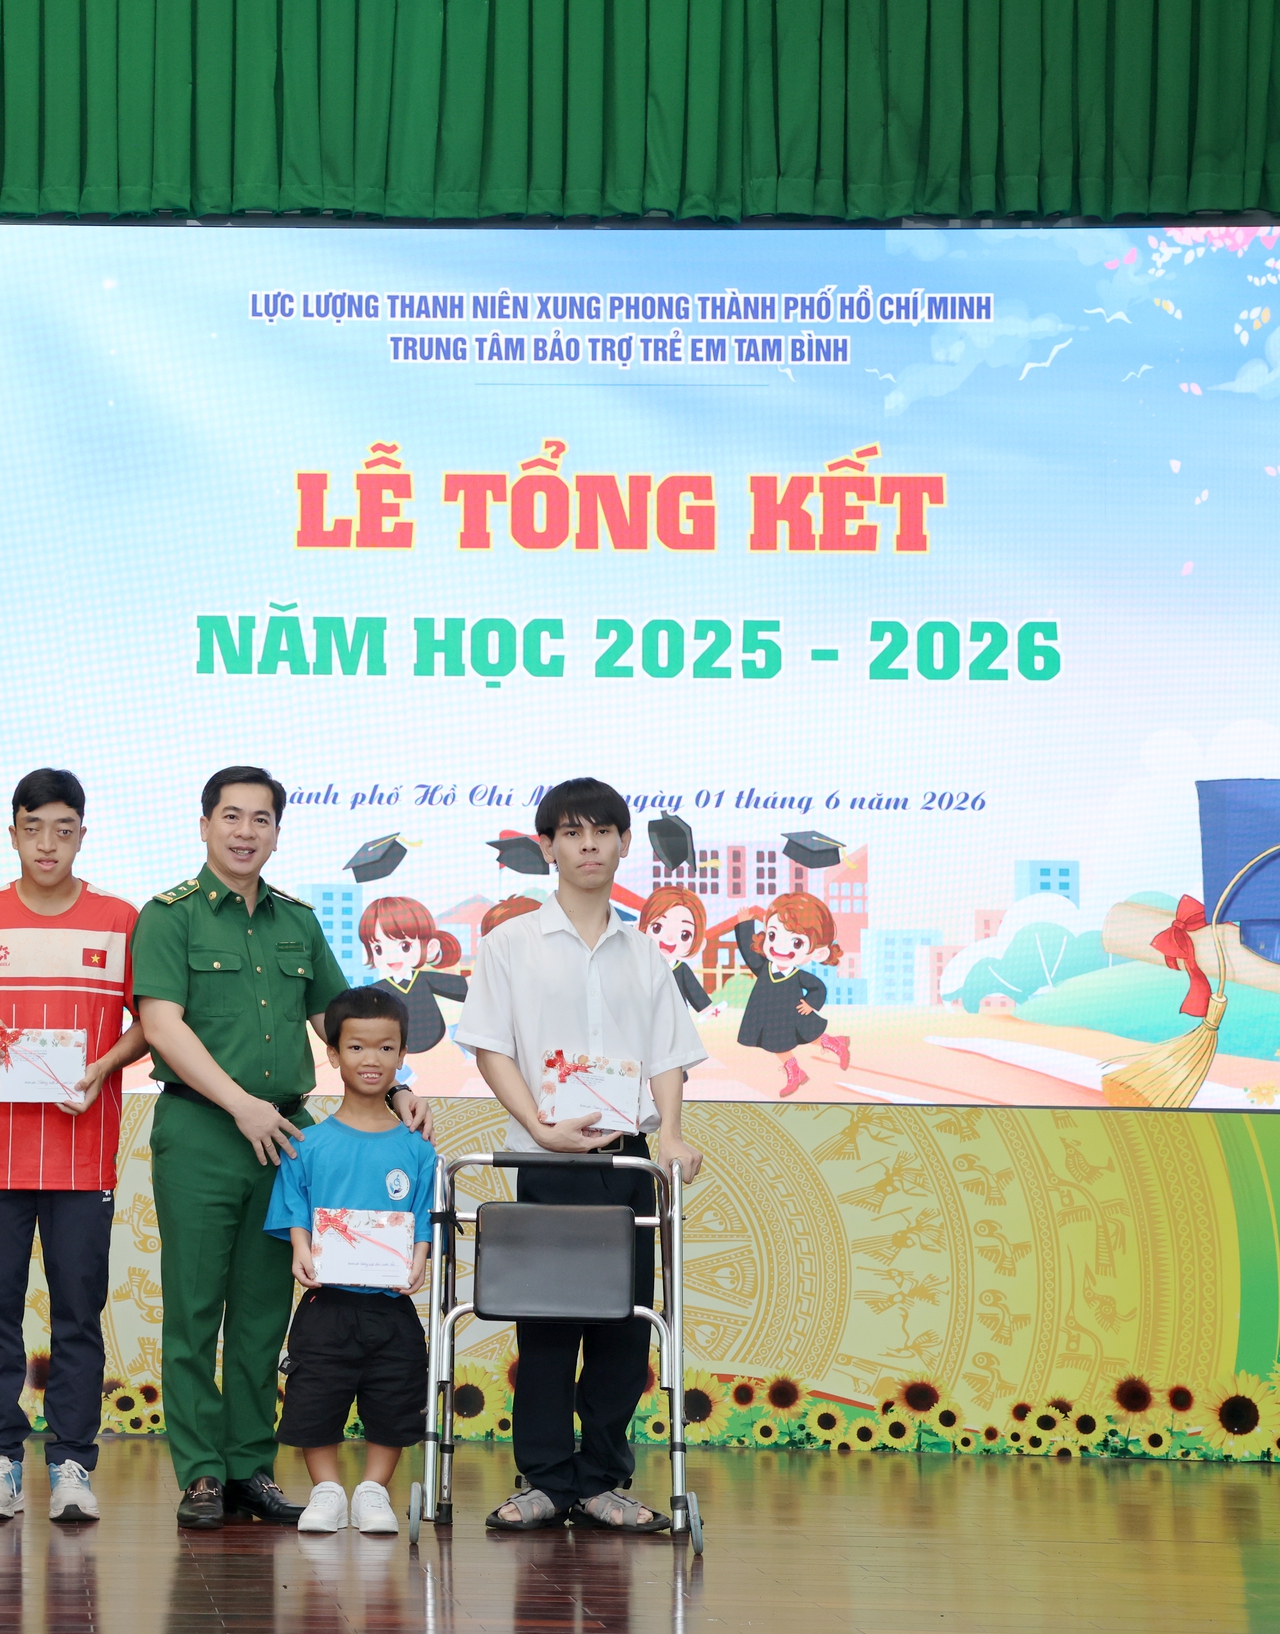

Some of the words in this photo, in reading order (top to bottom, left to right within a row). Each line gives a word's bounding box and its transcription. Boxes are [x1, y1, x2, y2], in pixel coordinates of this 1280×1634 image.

[251, 291, 295, 323] LỰC
[302, 291, 379, 324] LƯỢNG
[387, 295, 464, 319] THANH
[472, 290, 528, 319] NIÊN
[537, 296, 601, 320] XUNG
[609, 296, 690, 320] PHONG
[696, 288, 776, 320] THÀNH
[784, 286, 833, 320] PHỐ
[840, 286, 872, 320] HỒ
[879, 287, 919, 320] CHÍ
[927, 296, 991, 320] MINH
[390, 336, 467, 361] TRUNG
[475, 332, 525, 361] TÂM
[533, 329, 580, 361] BẢO
[588, 335, 633, 367] TRỢ
[640, 329, 682, 362] TRẺ
[691, 338, 726, 362] EM
[734, 338, 782, 362] TAM
[791, 333, 848, 362] BÌNH
[296, 442, 414, 548] LỄ
[444, 439, 716, 550] TỔNG
[750, 445, 945, 552] KẾT
[196, 602, 387, 676] NĂM
[414, 617, 566, 688] HỌC
[595, 619, 782, 679] 2025
[869, 621, 1061, 681] 2026
[287, 783, 340, 805] ành
[349, 783, 403, 811] phố
[414, 784, 458, 806] Hồ
[469, 784, 514, 807] Chí
[694, 789, 725, 809] 01
[734, 787, 815, 815] tháng
[825, 790, 841, 810] 6
[849, 792, 910, 811] năm
[920, 791, 987, 811] 2026
